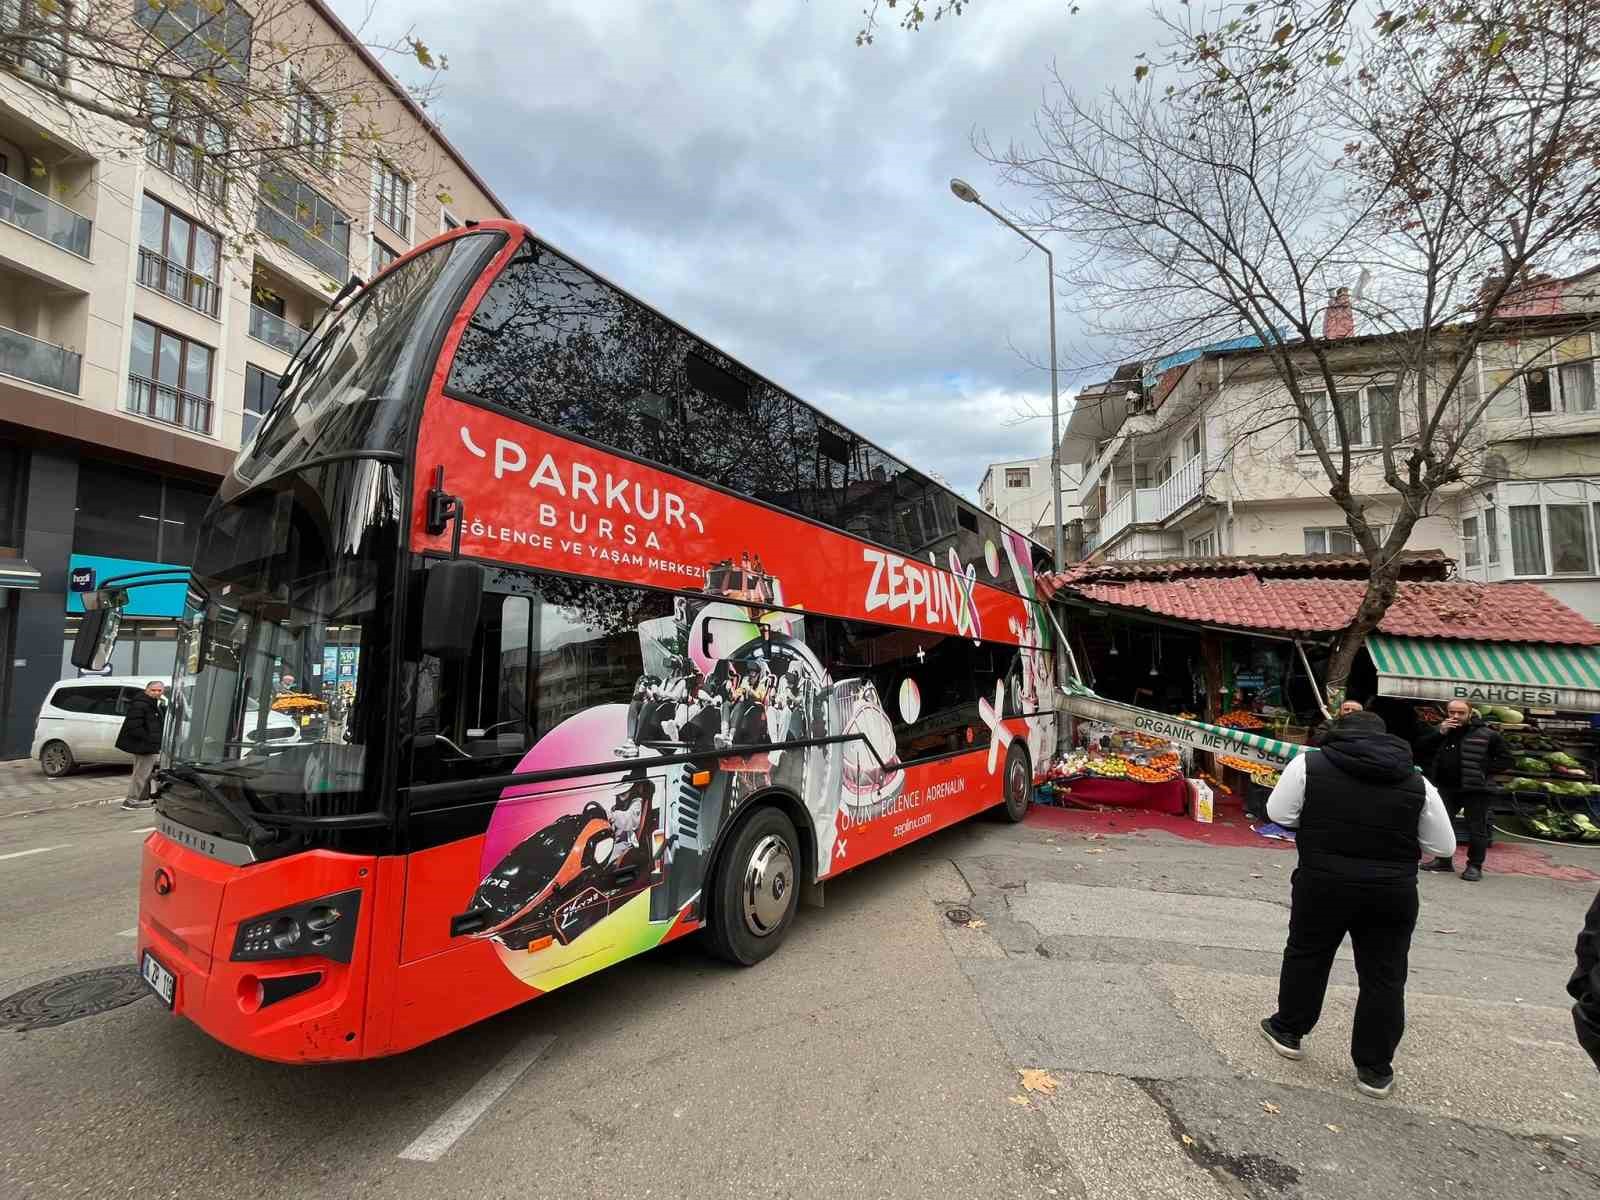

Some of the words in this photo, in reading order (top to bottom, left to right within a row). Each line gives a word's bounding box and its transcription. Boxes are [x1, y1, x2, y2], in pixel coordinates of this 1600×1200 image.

[494, 438, 686, 529] PARKUR
[460, 517, 553, 550] EĞLENCE
[560, 539, 582, 555] VE
[588, 544, 643, 566] YAŞAM
[648, 558, 705, 578] MERKEZİ
[539, 503, 661, 550] BURSA
[1202, 732, 1249, 756] MEYVE
